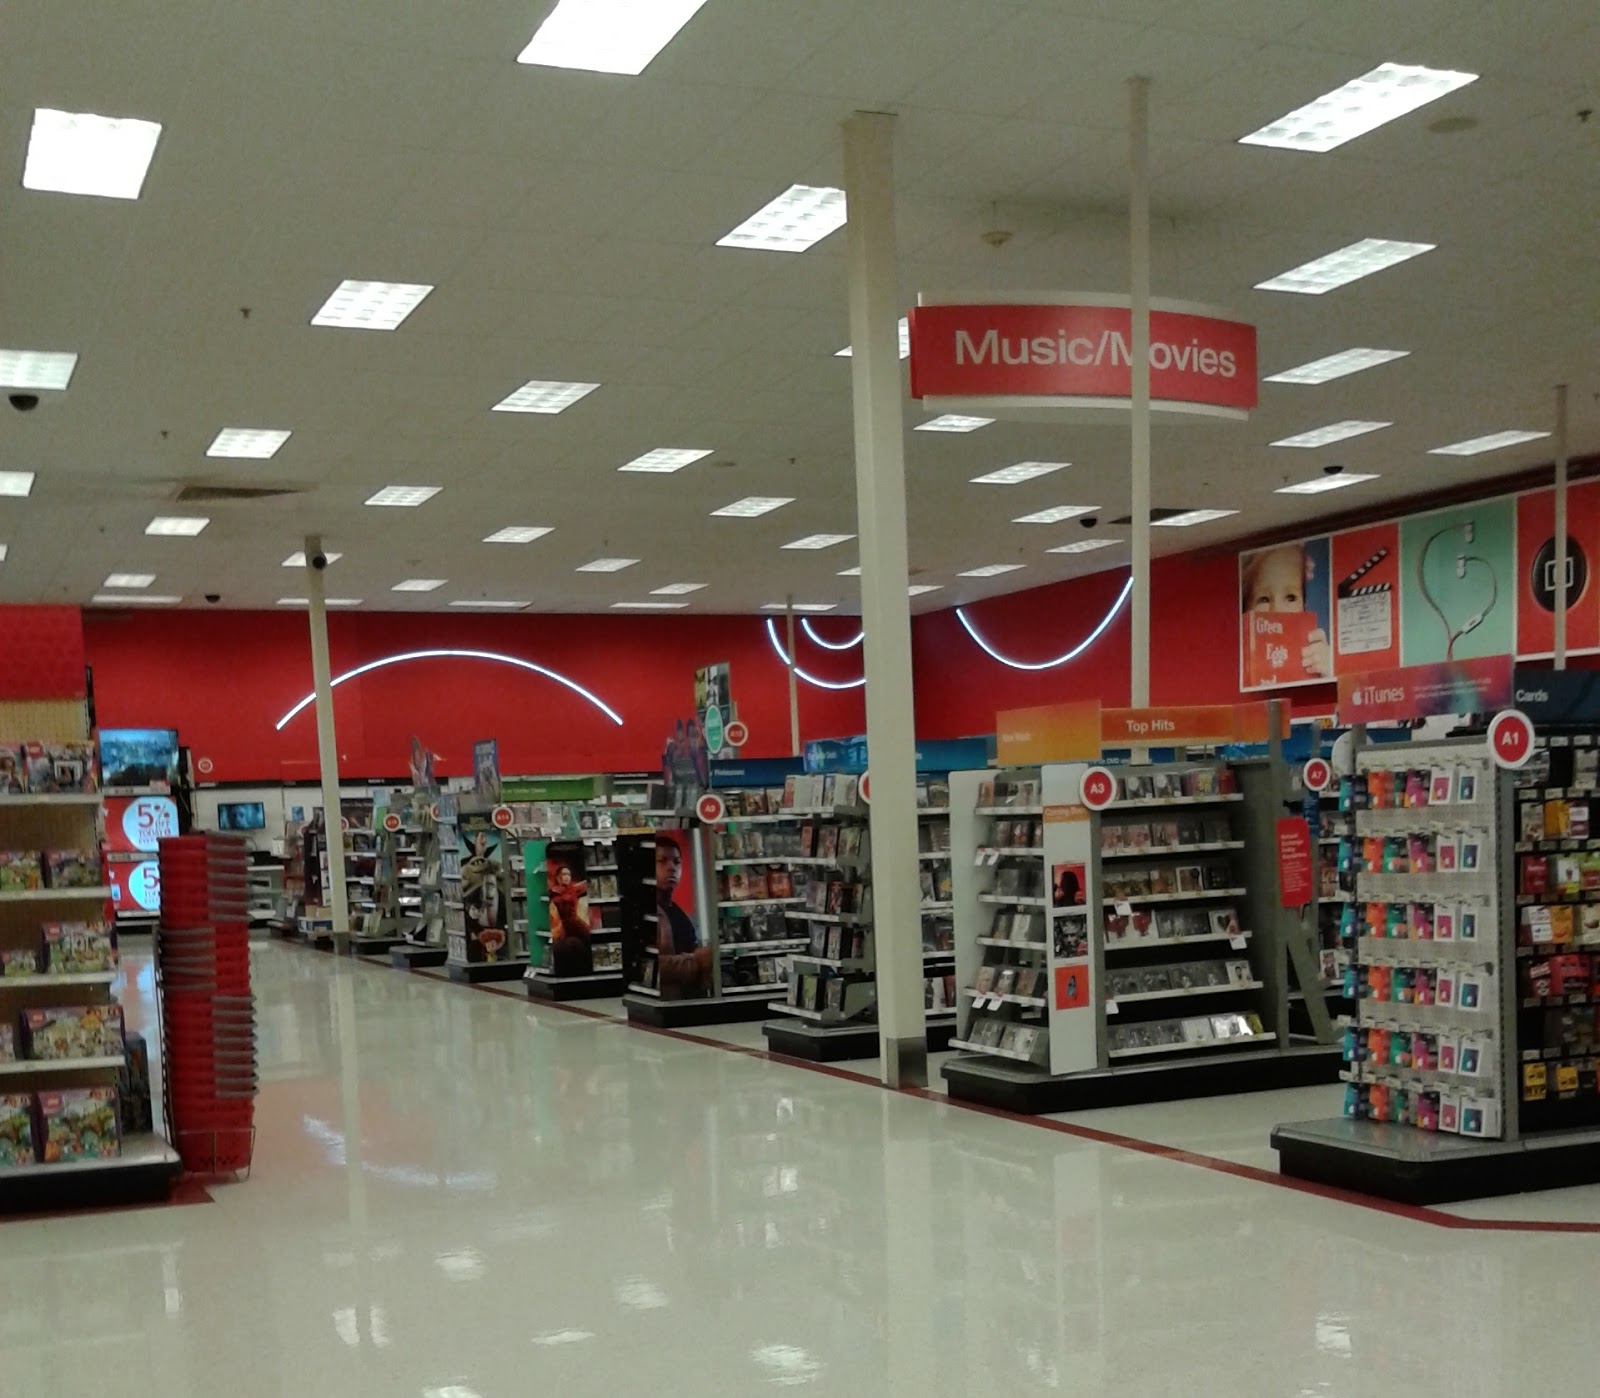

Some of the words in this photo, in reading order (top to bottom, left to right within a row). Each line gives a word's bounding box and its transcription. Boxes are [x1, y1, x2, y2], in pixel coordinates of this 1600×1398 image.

[1256, 617, 1283, 635] Green
[1364, 685, 1405, 705] iTunes
[1515, 689, 1549, 702] Cards
[1126, 719, 1149, 735] Top
[1151, 719, 1176, 731] Hits
[1501, 731, 1520, 746] A1
[1311, 770, 1324, 779] A7
[1090, 782, 1105, 794] A3
[137, 802, 170, 828] 5%
[704, 804, 716, 813] A9
